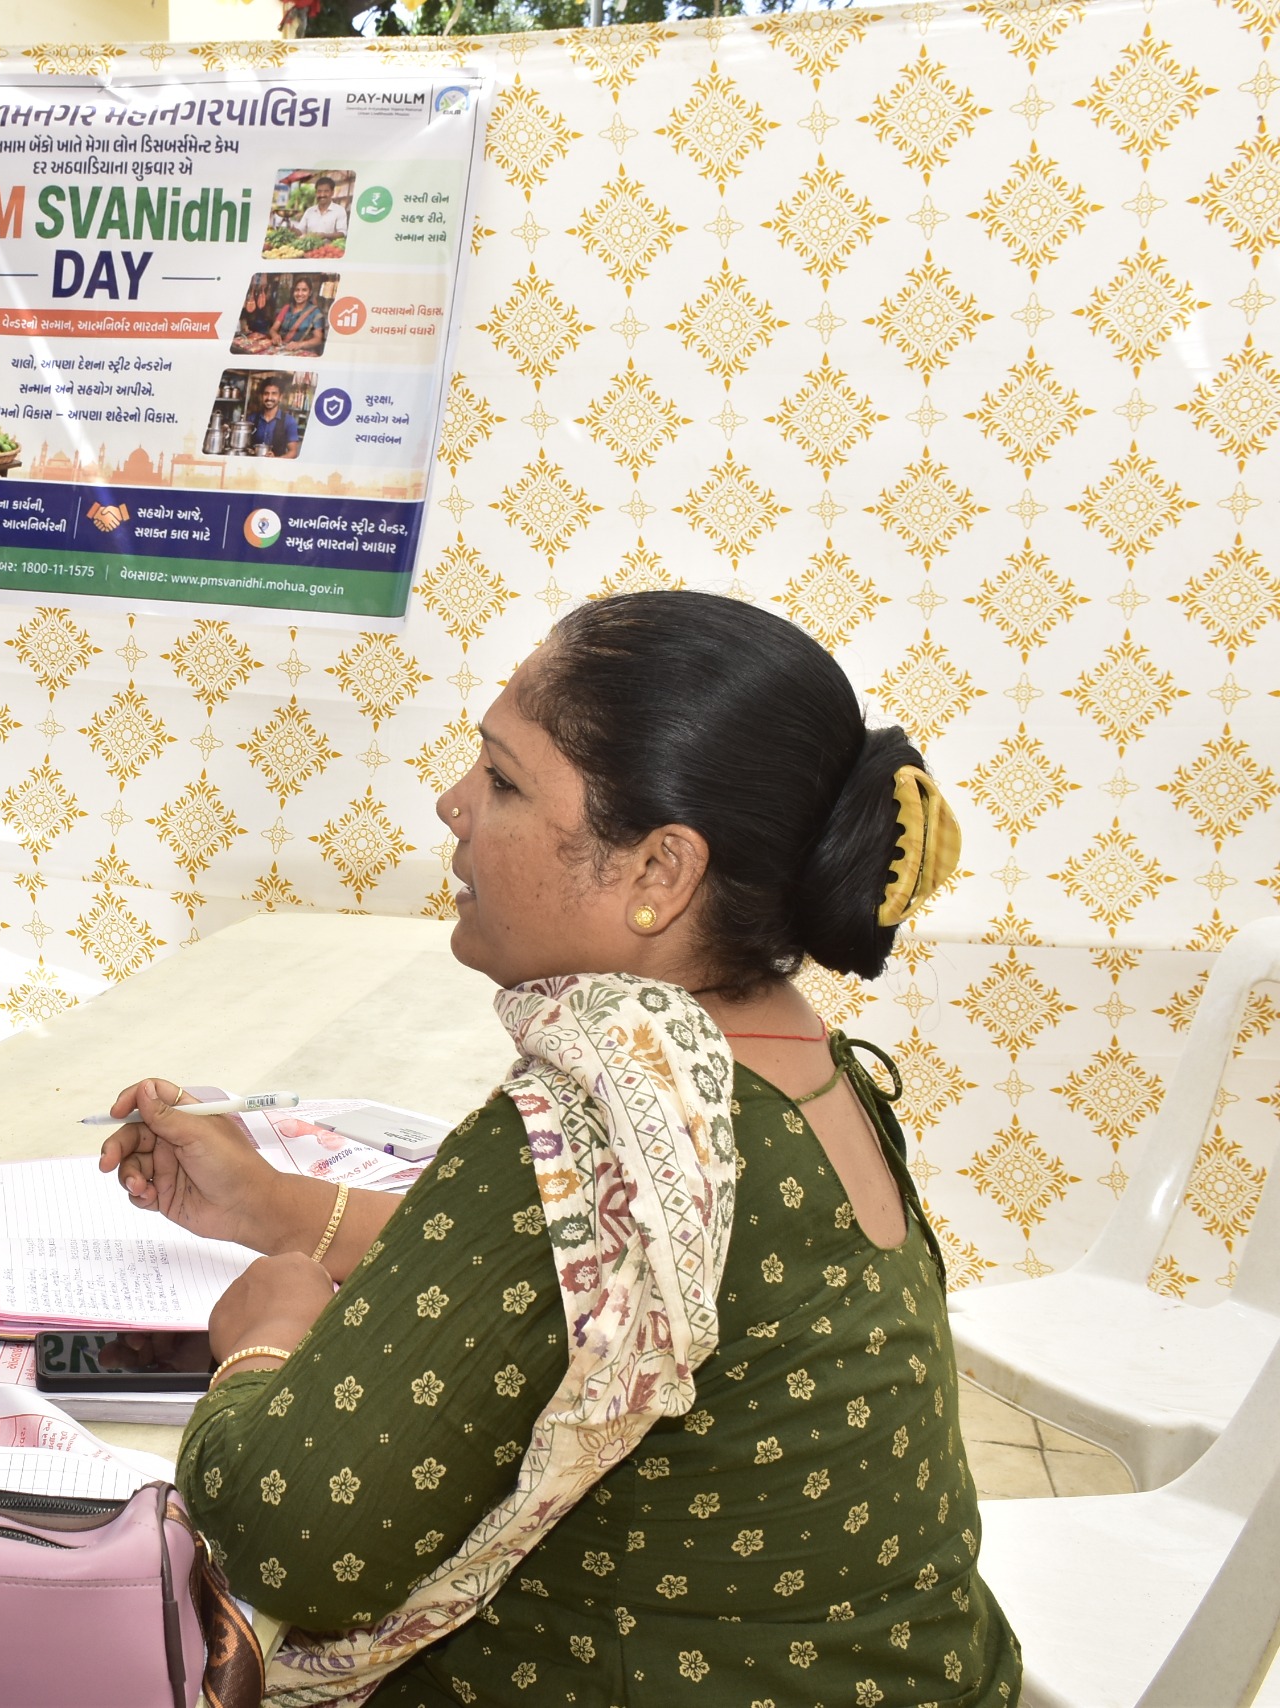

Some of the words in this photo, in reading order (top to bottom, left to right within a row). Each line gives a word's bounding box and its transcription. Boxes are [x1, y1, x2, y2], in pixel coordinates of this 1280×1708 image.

[105, 87, 331, 127] મહાનગરપાલિકા
[346, 92, 426, 105] DAY-NULM
[29, 134, 53, 153] બેંકો
[56, 134, 82, 153] ખાતે
[85, 134, 109, 153] મેગા
[113, 134, 138, 153] લોન
[141, 133, 212, 154] ડિસબર્સમેન્ટ
[214, 135, 239, 154] કેમ્પ
[32, 161, 47, 175] દર
[50, 155, 128, 175] અઠવાડિયાના
[178, 156, 193, 176] એ
[403, 192, 428, 204] સસ્તી
[431, 192, 449, 204] લોન
[35, 185, 252, 243] SVANidhi
[427, 231, 447, 243] સાથે
[51, 249, 154, 300] DAY
[41, 318, 75, 332] સન્માન,
[77, 316, 131, 331] આત્મનિર્ભર
[133, 317, 169, 332] ભારતનો
[170, 317, 211, 333] અભિયાન
[370, 324, 407, 335] આવકમાં
[409, 324, 436, 335] વધારો
[10, 354, 37, 370] ચાલો,
[40, 358, 75, 370] આપણા
[77, 355, 105, 370] દેશના
[19, 383, 52, 394] સન્માન
[54, 380, 74, 395] અને
[76, 381, 112, 396] સહયોગ
[115, 382, 155, 397] આપીએ.
[22, 404, 53, 420] વિકાસ
[67, 409, 102, 421] આપણા
[105, 406, 141, 423] શહેરનો
[144, 407, 179, 424] વિકાસ.
[355, 412, 388, 424] સહયોગ
[391, 413, 410, 425] અને
[12, 497, 45, 514] કાર્યની,
[137, 505, 173, 519] સહયોગ
[176, 506, 204, 523] આજે,
[2, 516, 67, 533] આત્મનિર્ભરની
[287, 515, 348, 531] આત્મનિર્ભર
[378, 518, 409, 537] વેન્ડર,
[134, 526, 167, 539] સશક્ત
[170, 529, 189, 540] કાલ
[192, 527, 211, 541] માટે
[285, 536, 314, 552] સમૃદ્ધ
[316, 536, 359, 552] ભારતનો
[361, 541, 397, 554] આધાર
[21, 561, 95, 577] 1800-11-1575
[171, 573, 344, 596] www.pmsvanidhi.mohua.gov.in
